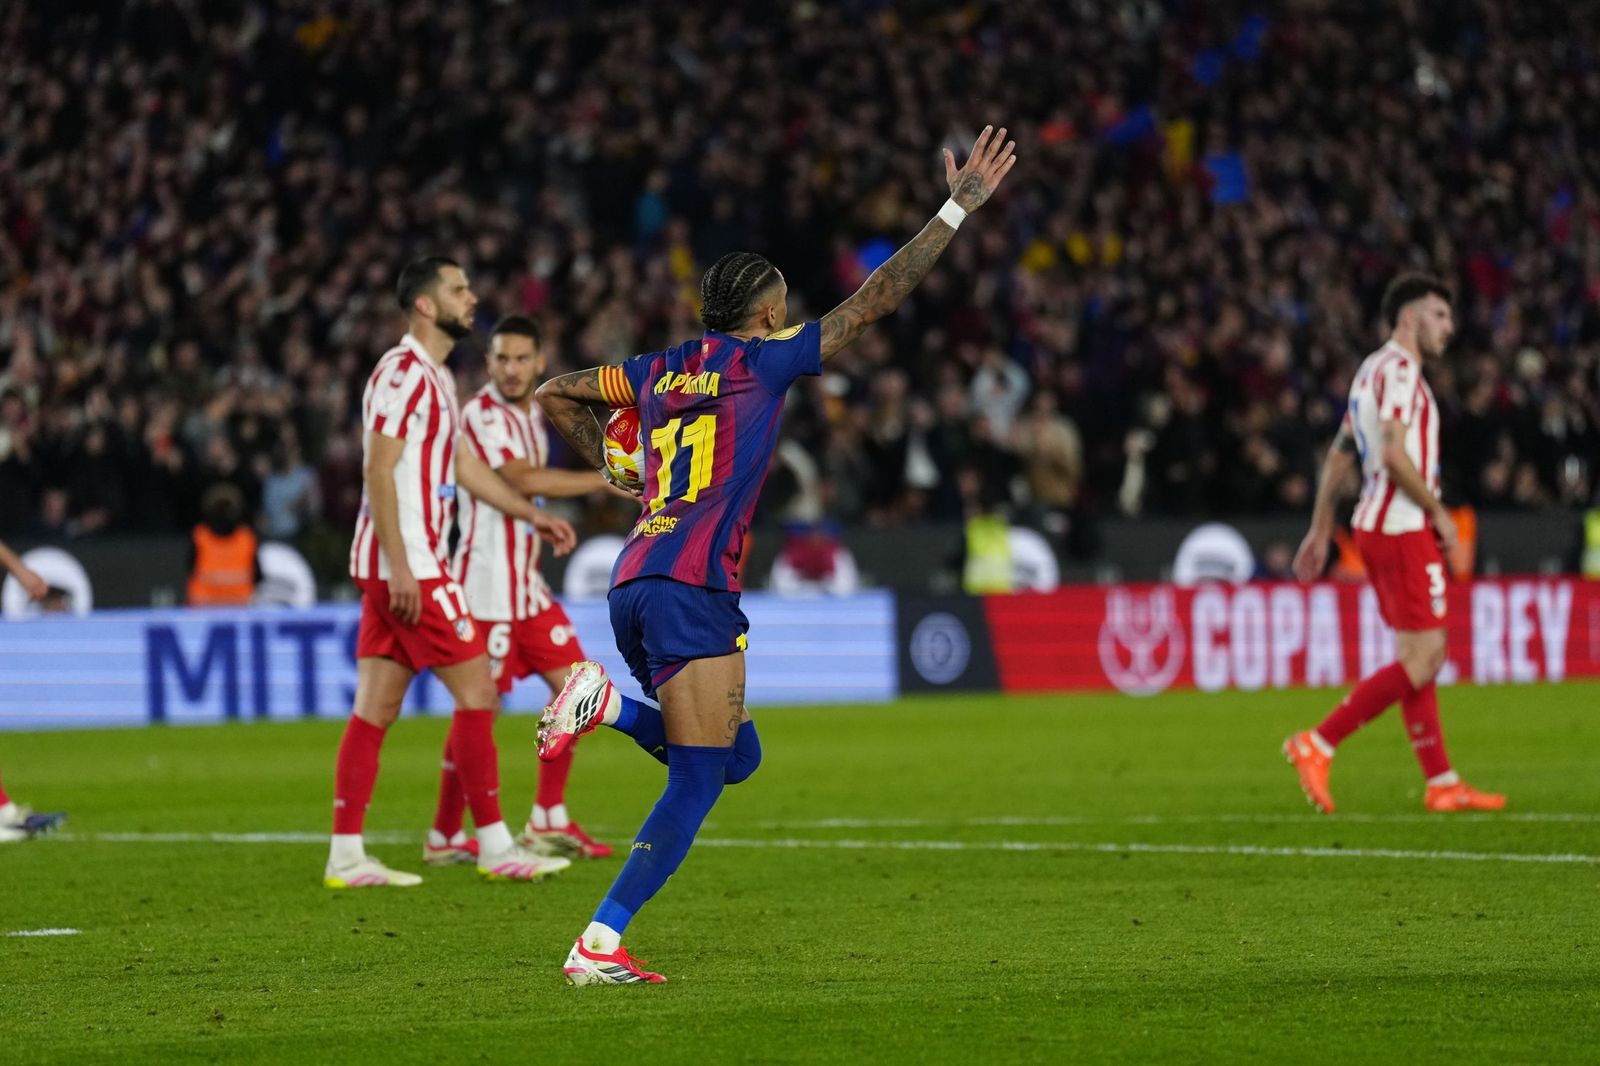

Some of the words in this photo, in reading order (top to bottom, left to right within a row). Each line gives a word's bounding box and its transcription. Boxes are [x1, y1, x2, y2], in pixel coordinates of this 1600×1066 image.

[649, 414, 717, 515] 11
[1425, 563, 1446, 596] 3
[432, 582, 470, 621] 17
[487, 622, 512, 657] 6
[1192, 583, 1345, 691] COPA
[1471, 581, 1574, 684] REY
